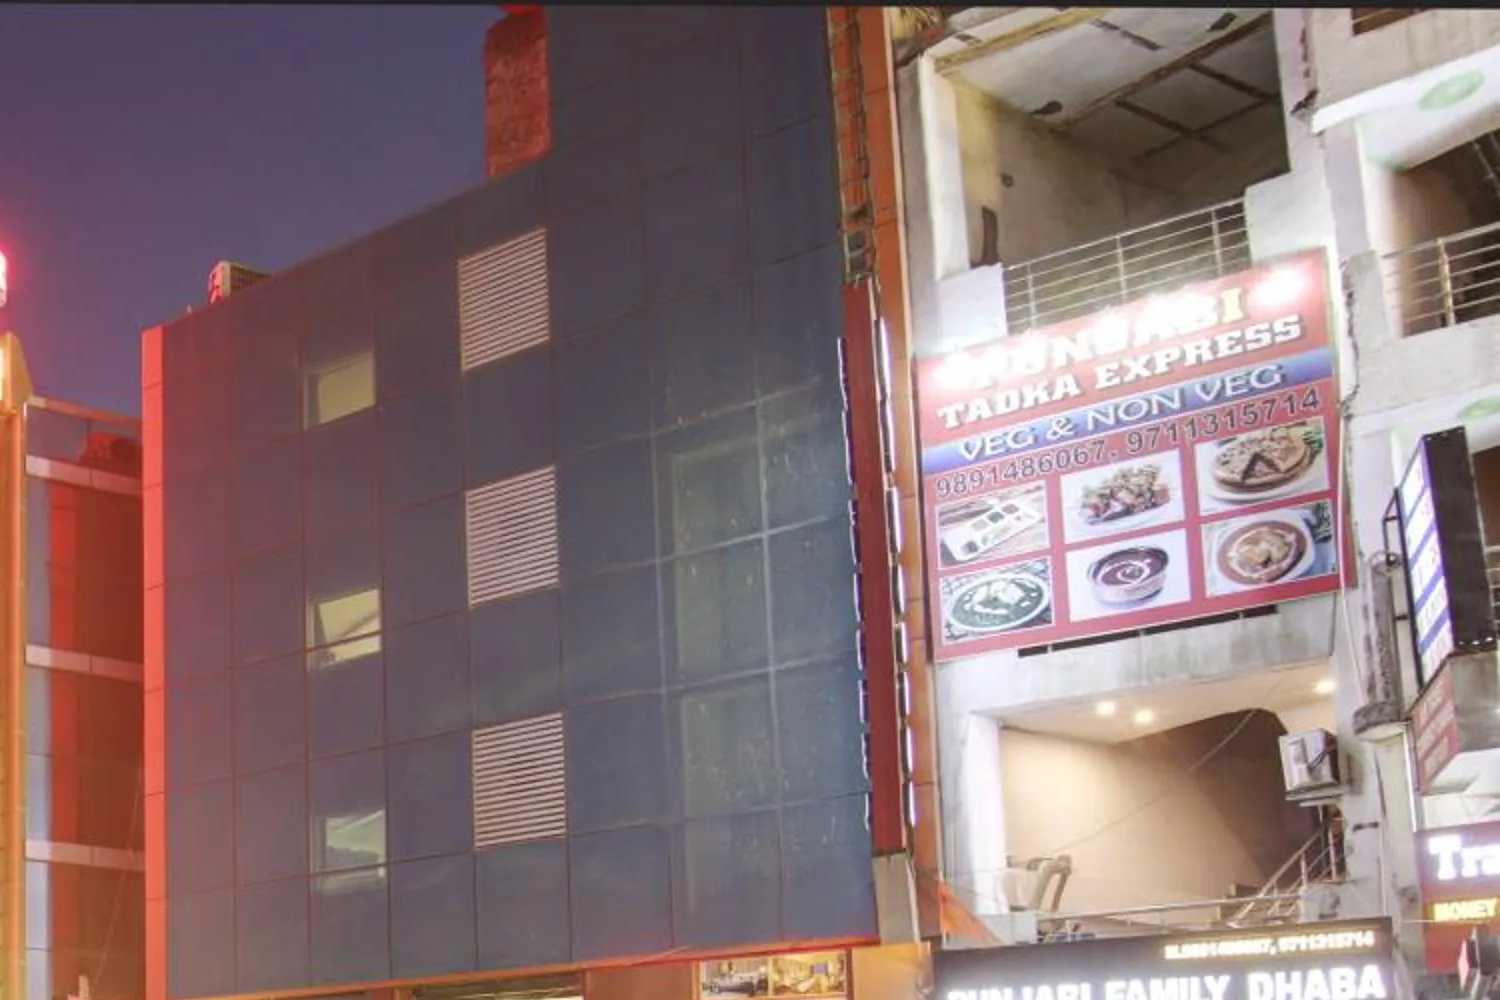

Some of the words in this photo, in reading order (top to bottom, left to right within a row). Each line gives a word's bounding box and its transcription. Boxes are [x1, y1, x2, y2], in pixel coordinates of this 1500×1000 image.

[936, 373, 1082, 429] TADKA
[1095, 314, 1302, 390] EXPRESS
[958, 427, 1036, 462] VEG
[1046, 416, 1076, 440] &
[1086, 387, 1184, 431] NON
[1193, 363, 1284, 402] VEG
[1126, 386, 1320, 452] 9711315714
